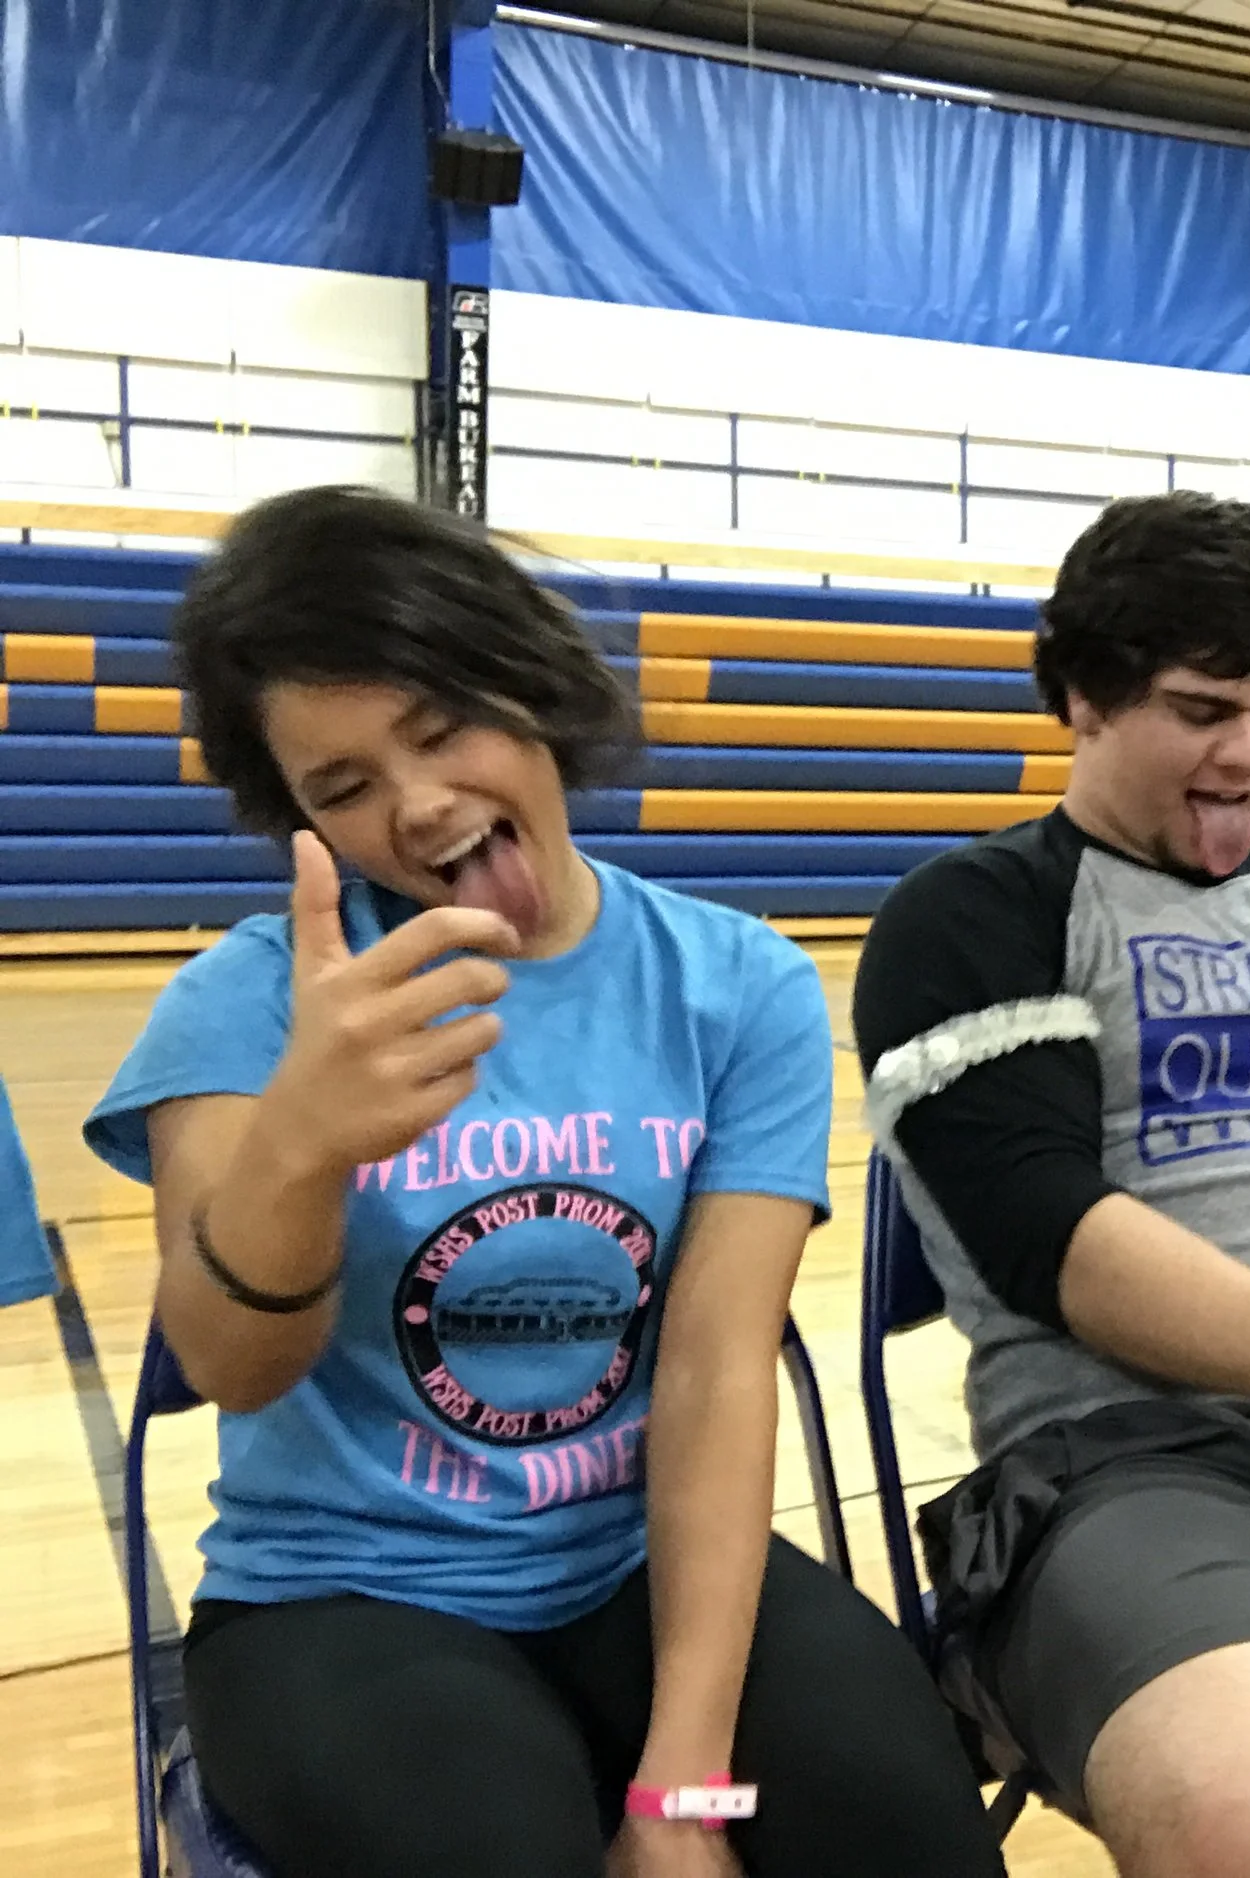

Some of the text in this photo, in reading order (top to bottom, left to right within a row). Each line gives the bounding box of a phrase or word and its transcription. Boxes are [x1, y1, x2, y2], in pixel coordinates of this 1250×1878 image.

[640, 1116, 705, 1179] TO
[474, 1192, 539, 1235] POST
[552, 1192, 625, 1236] PROM
[421, 1364, 475, 1420] WSHS
[472, 1404, 536, 1438] POST
[398, 1420, 492, 1503] THE
